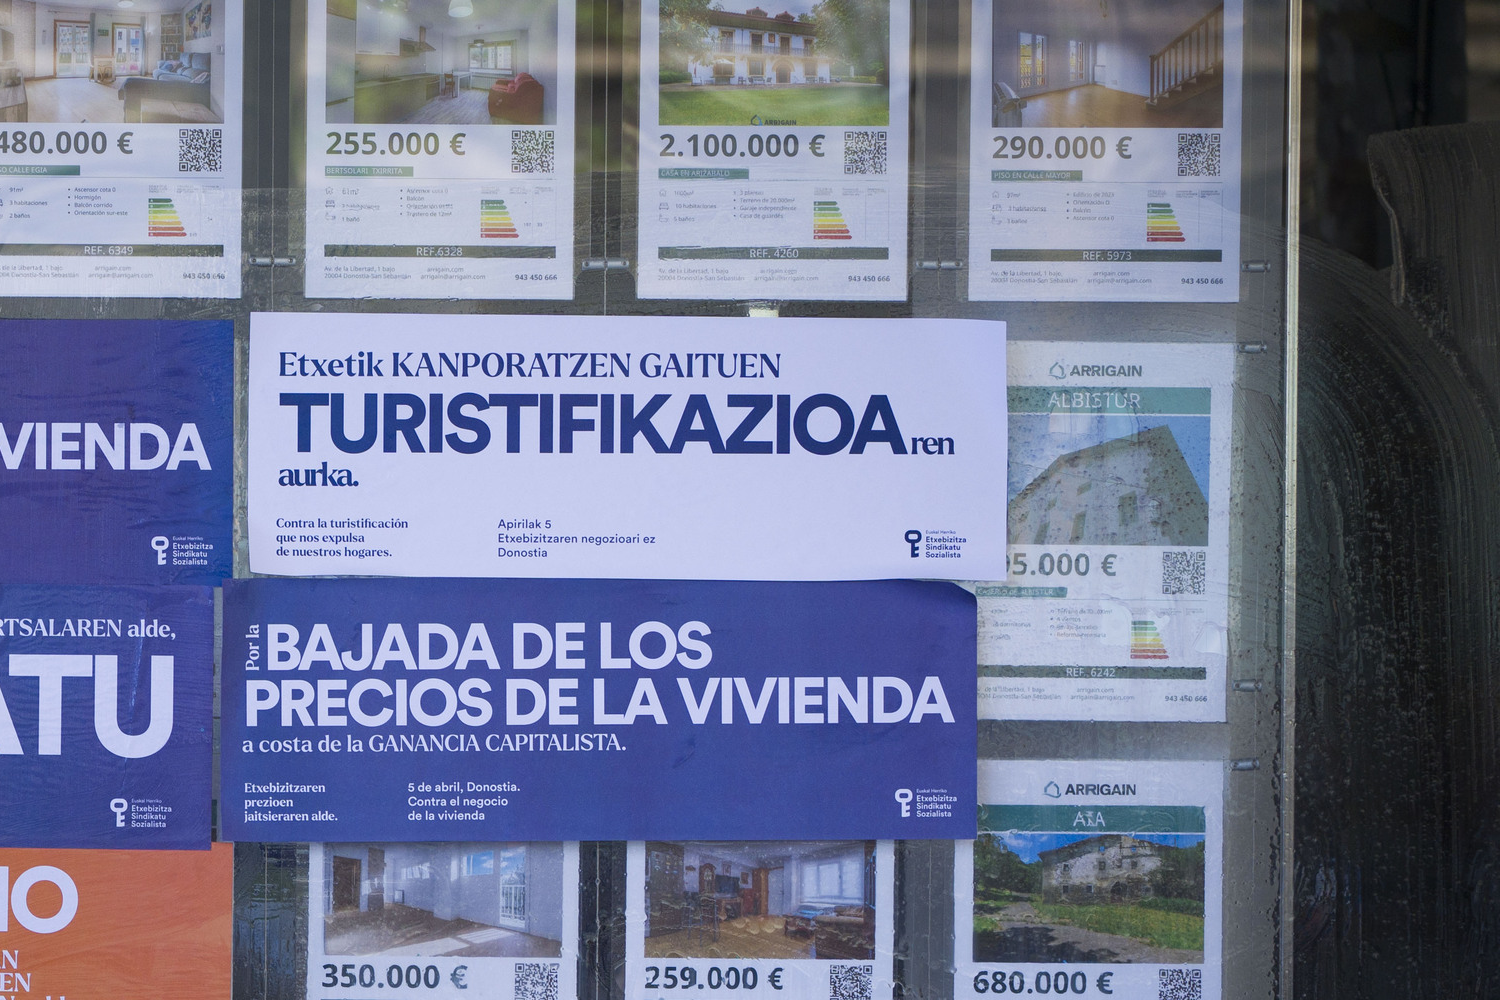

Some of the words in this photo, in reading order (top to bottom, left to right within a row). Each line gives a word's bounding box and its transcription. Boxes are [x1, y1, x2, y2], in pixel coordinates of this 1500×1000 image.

[117, 132, 133, 154] €
[326, 132, 439, 155] 255.000
[450, 133, 466, 155] €
[660, 134, 798, 157] 2.100.000
[809, 135, 825, 157] €
[993, 136, 1105, 159] 290.000
[1116, 136, 1132, 159] €
[750, 249, 770, 258] REF.
[774, 248, 798, 258] 4260
[1083, 251, 1103, 260] REF.
[1107, 251, 1131, 260] 5973
[280, 351, 383, 376] Etxetik
[393, 353, 630, 377] KANPORATZEN
[640, 353, 780, 378] GAITUEN
[1070, 365, 1142, 376] ARRIGAIN
[1048, 392, 1140, 408] ALBISTUR
[279, 462, 359, 486] aurka.
[498, 519, 541, 530] Apirilak
[545, 520, 551, 528] 5
[499, 534, 577, 543] Etxebizitzaren
[582, 534, 639, 545] negozioari
[173, 550, 207, 559] Sindikatu
[499, 548, 547, 557] Donostia
[128, 619, 175, 640] alde,
[268, 623, 500, 671] BAJADA
[513, 623, 585, 669] DE
[601, 621, 712, 669] LOS
[246, 678, 492, 727] PRECIOS
[506, 679, 578, 725] DE
[594, 678, 668, 724] LA
[677, 676, 955, 724] VIVIENDA
[1065, 784, 1136, 795] ARRIGAIN
[322, 964, 440, 988] 350.000
[450, 965, 468, 989] €
[645, 966, 757, 989] 259.000
[768, 968, 783, 990] €
[974, 971, 1086, 994] 680.000
[1096, 972, 1113, 994] €
